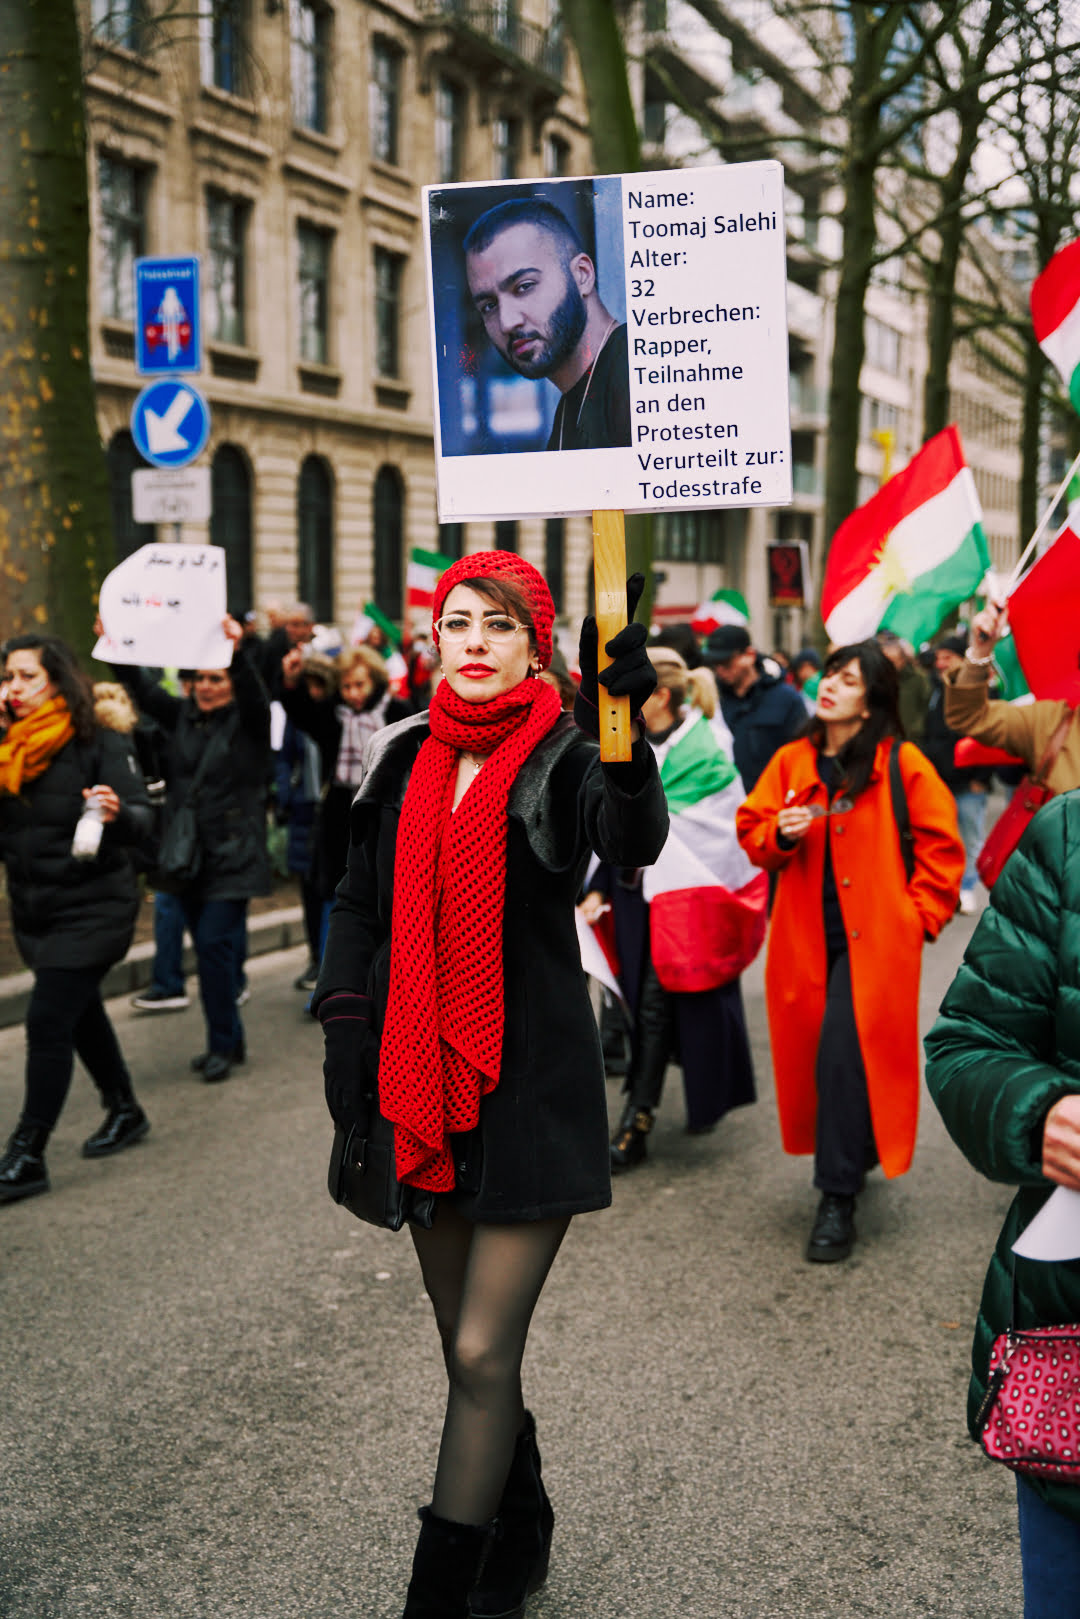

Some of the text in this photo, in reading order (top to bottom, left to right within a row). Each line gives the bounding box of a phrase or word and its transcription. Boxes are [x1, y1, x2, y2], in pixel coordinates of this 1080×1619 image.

[629, 192, 693, 209] Name:
[629, 212, 776, 238] Toomaj Salehi
[631, 249, 686, 268] Alter:
[632, 280, 654, 297] 32
[632, 304, 759, 326] Verbrechen:
[635, 339, 711, 357] Rapper,
[634, 364, 742, 384] Teilnahme
[636, 394, 704, 413] an den
[638, 423, 737, 442] Protesten
[638, 449, 783, 470] Verurteilt zur:
[639, 476, 761, 499] Todesstrafe
